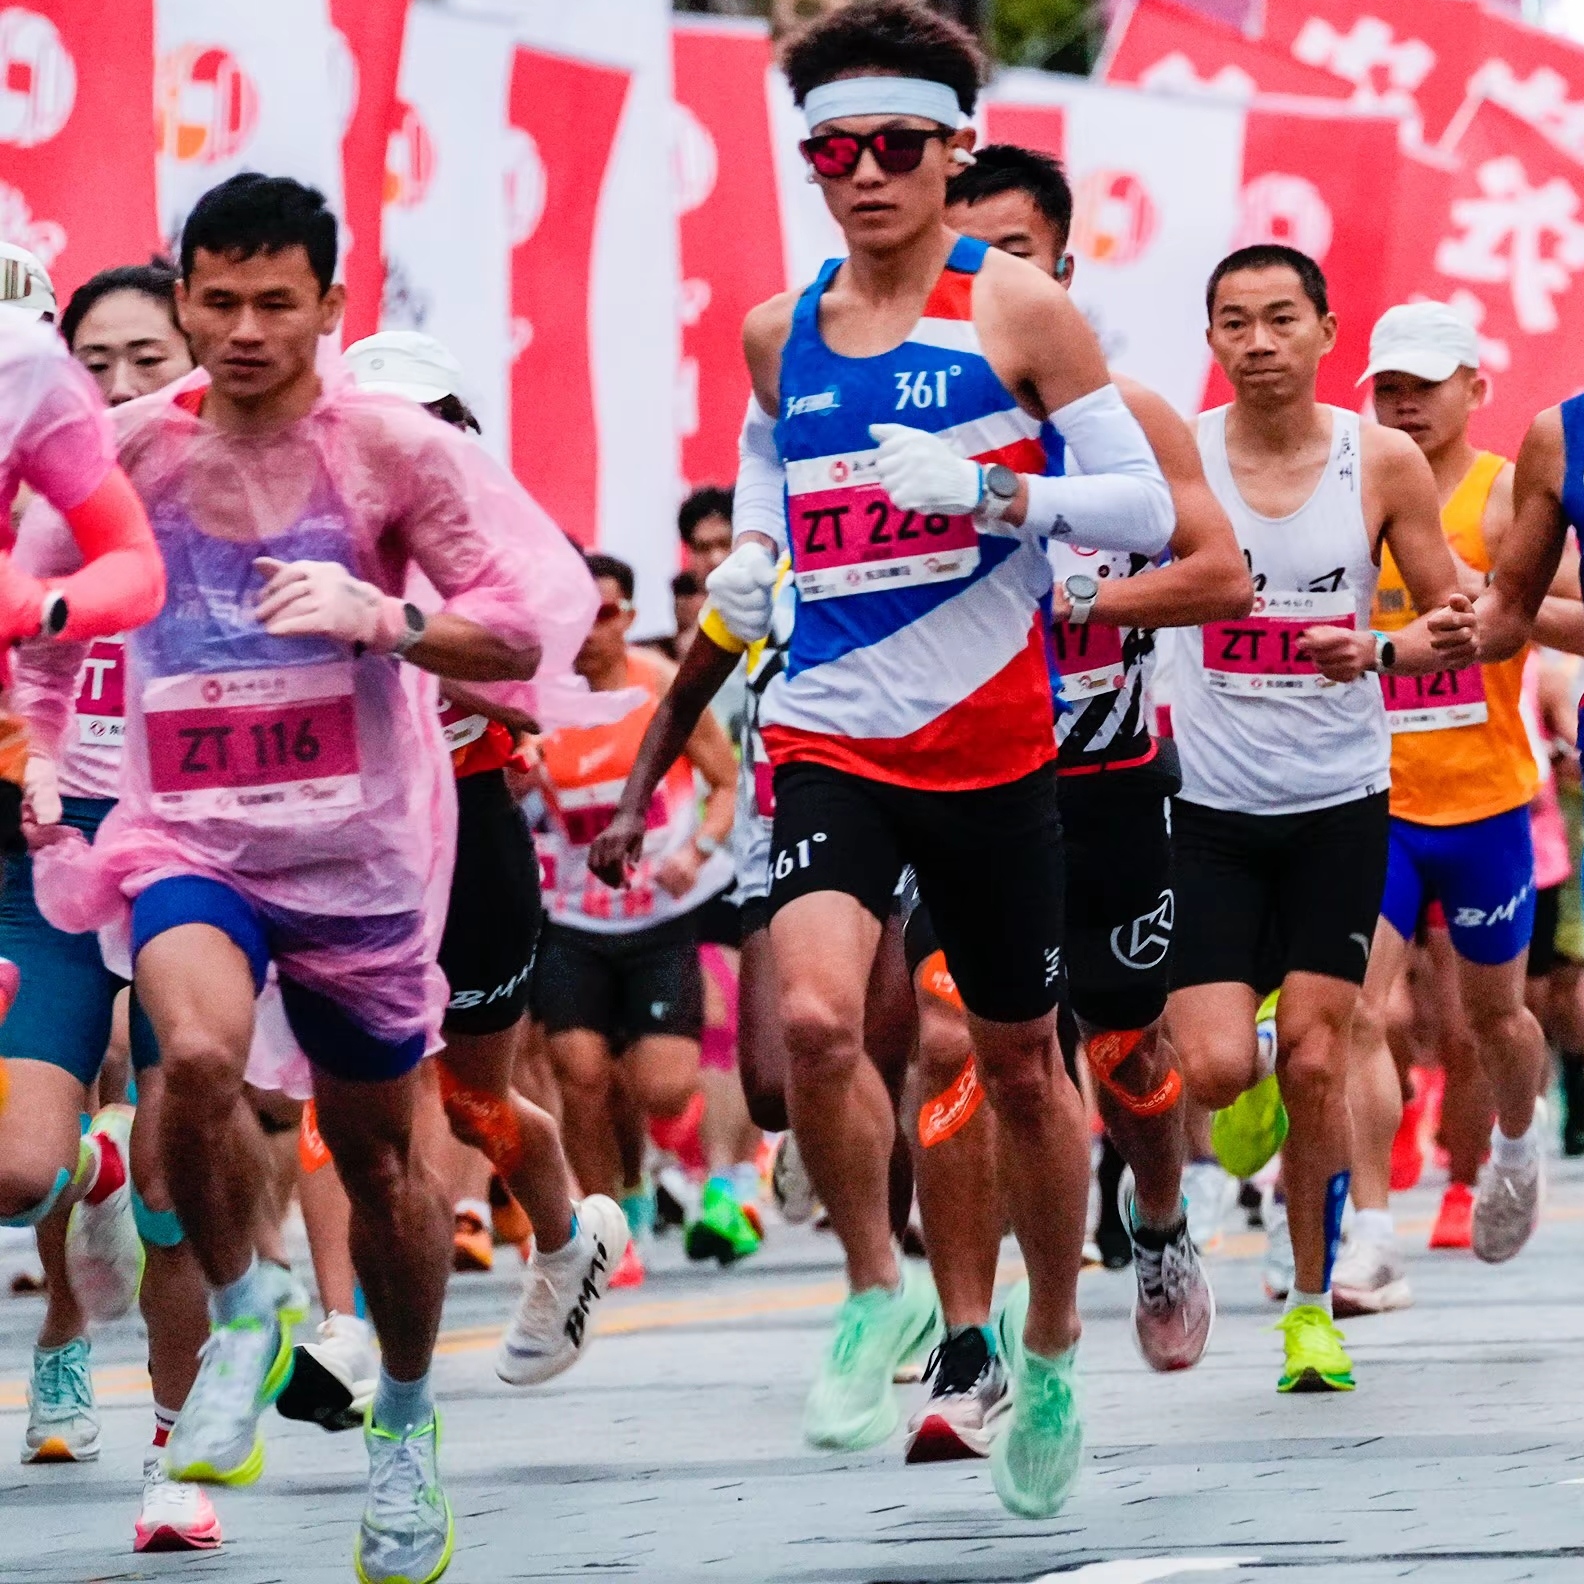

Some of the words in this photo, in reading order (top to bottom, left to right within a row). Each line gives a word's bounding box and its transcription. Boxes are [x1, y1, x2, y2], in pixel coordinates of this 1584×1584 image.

[893, 364, 962, 411] 361°
[802, 505, 849, 554] ZT
[1220, 628, 1267, 662] ZT
[178, 725, 235, 774] ZT
[251, 718, 321, 767] 116
[767, 831, 828, 886] 61°
